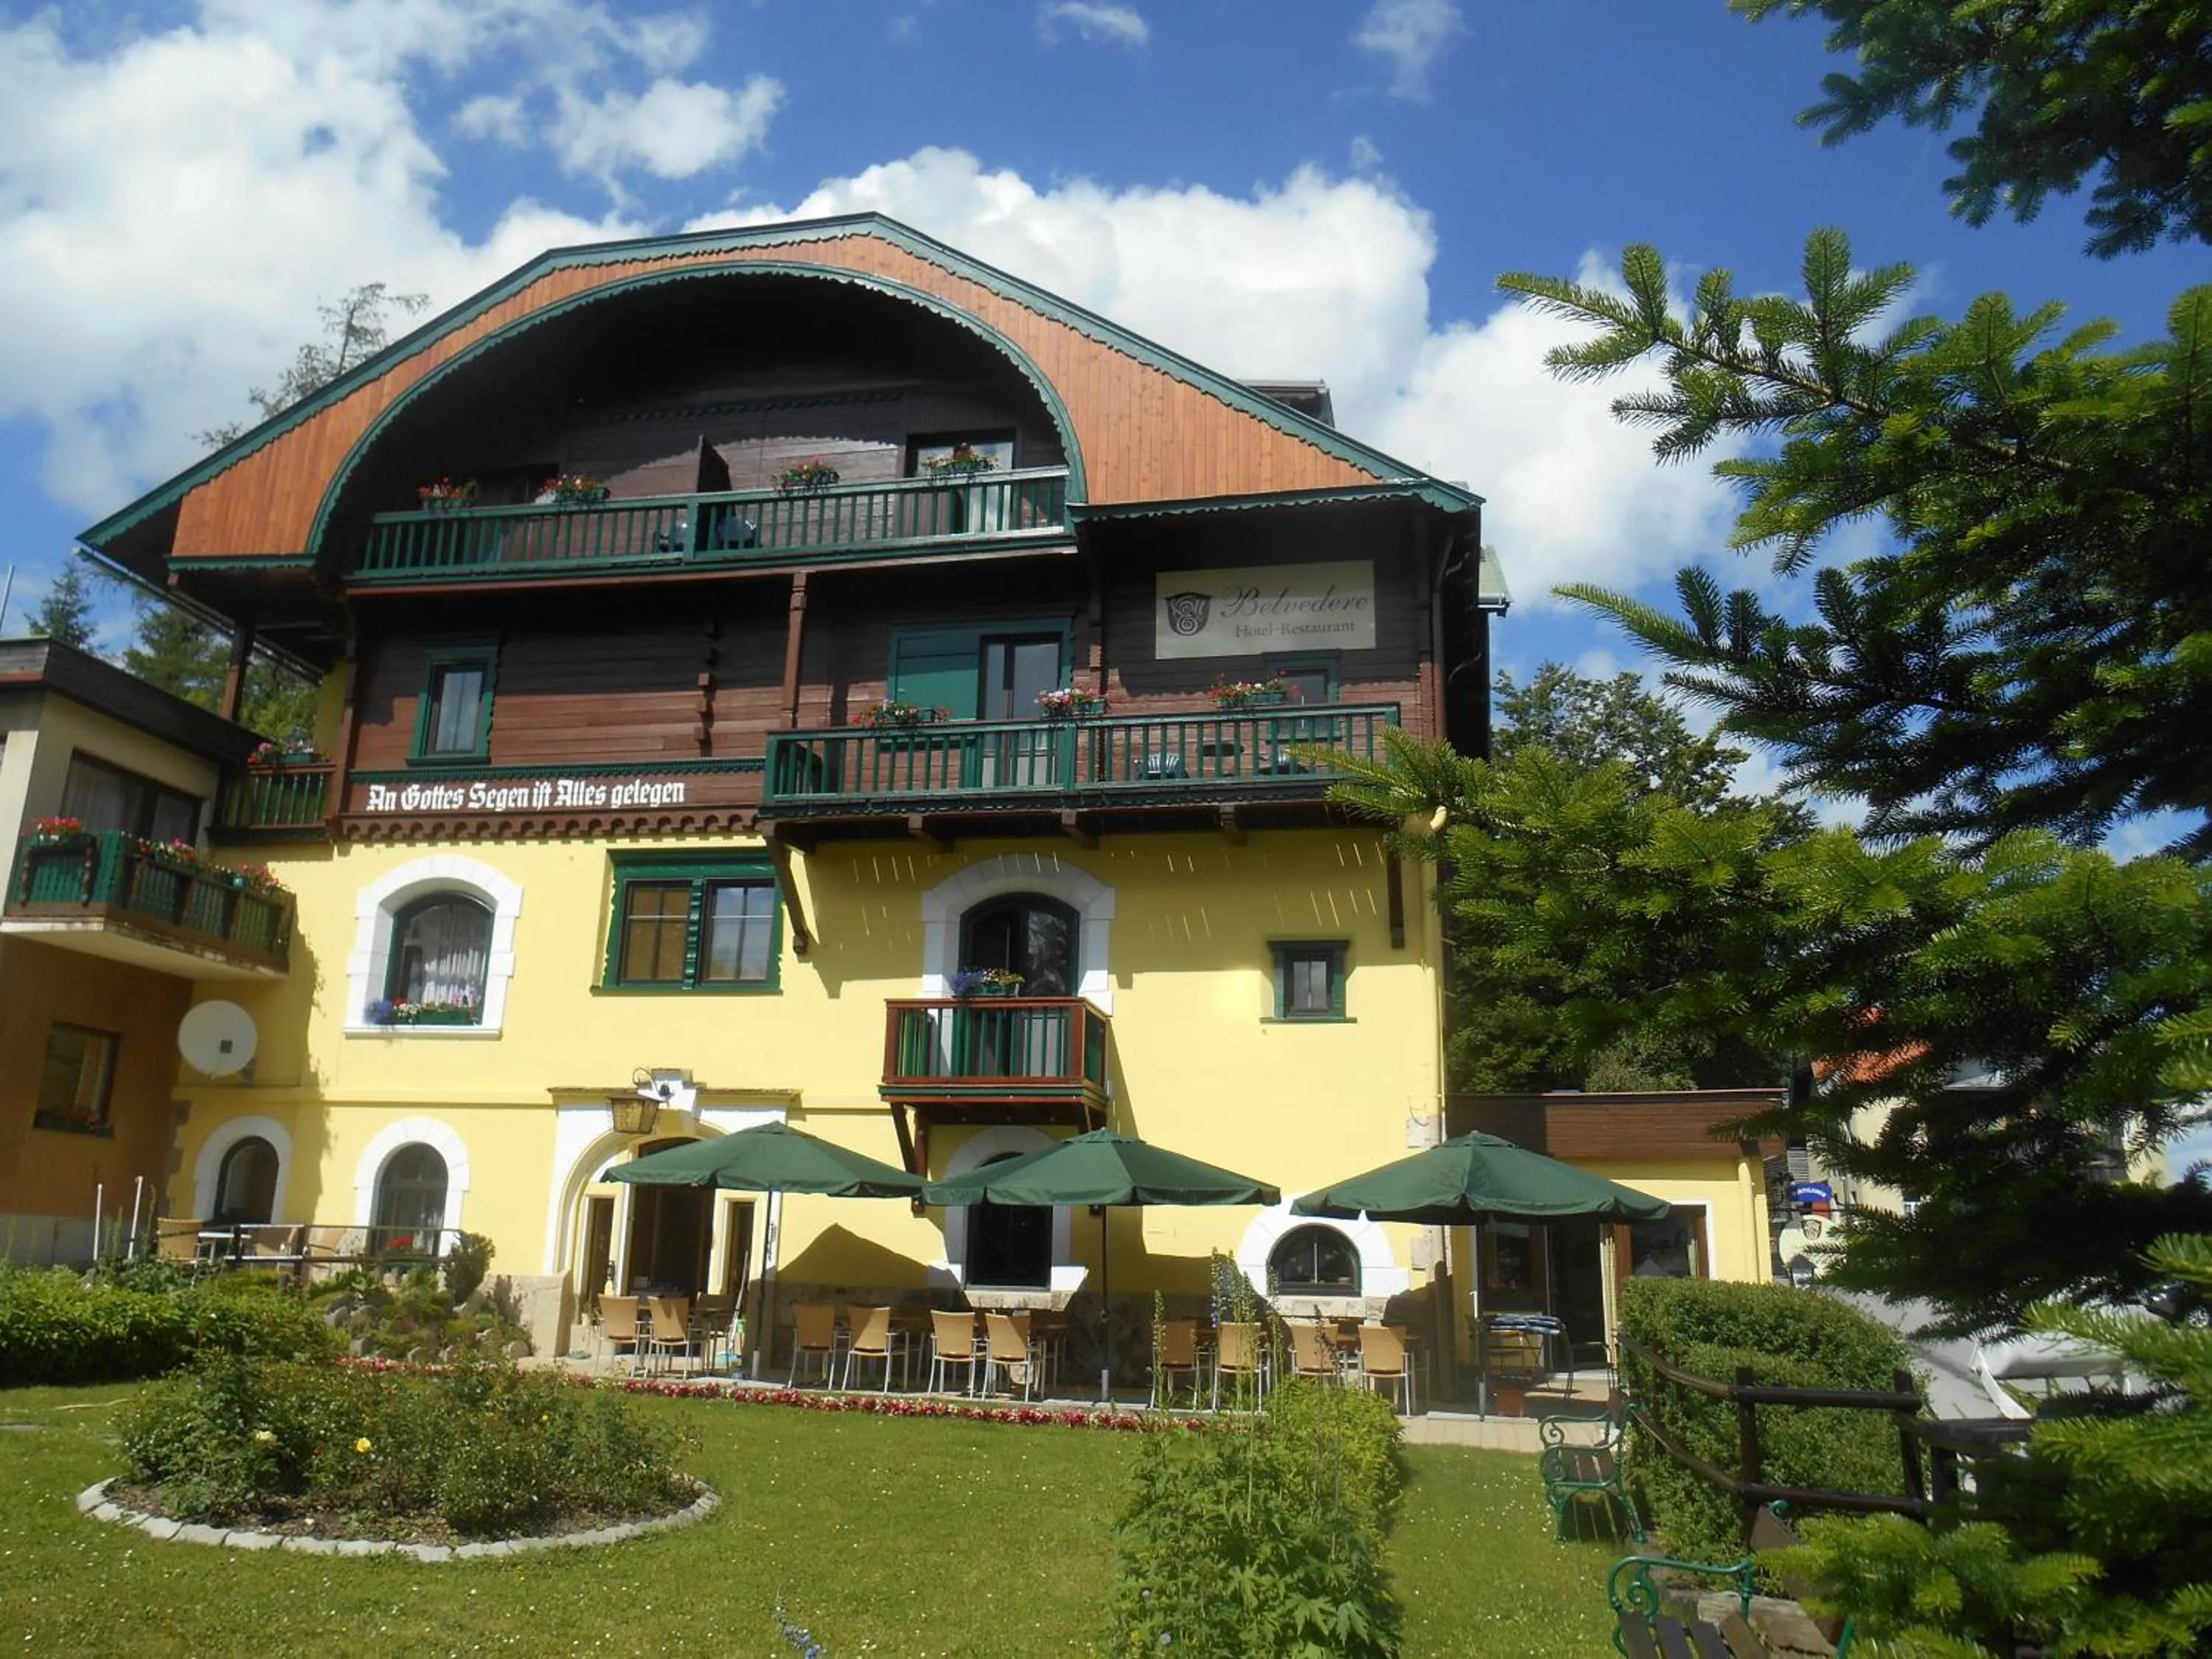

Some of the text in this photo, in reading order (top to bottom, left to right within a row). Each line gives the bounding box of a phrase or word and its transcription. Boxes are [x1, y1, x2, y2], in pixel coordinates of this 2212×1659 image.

[1220, 585, 1368, 618] Belvedere
[366, 785, 396, 811] An
[401, 784, 464, 810] Gottes
[467, 782, 529, 812] Segen
[555, 779, 606, 807] Alles
[611, 779, 685, 807] gelegen
